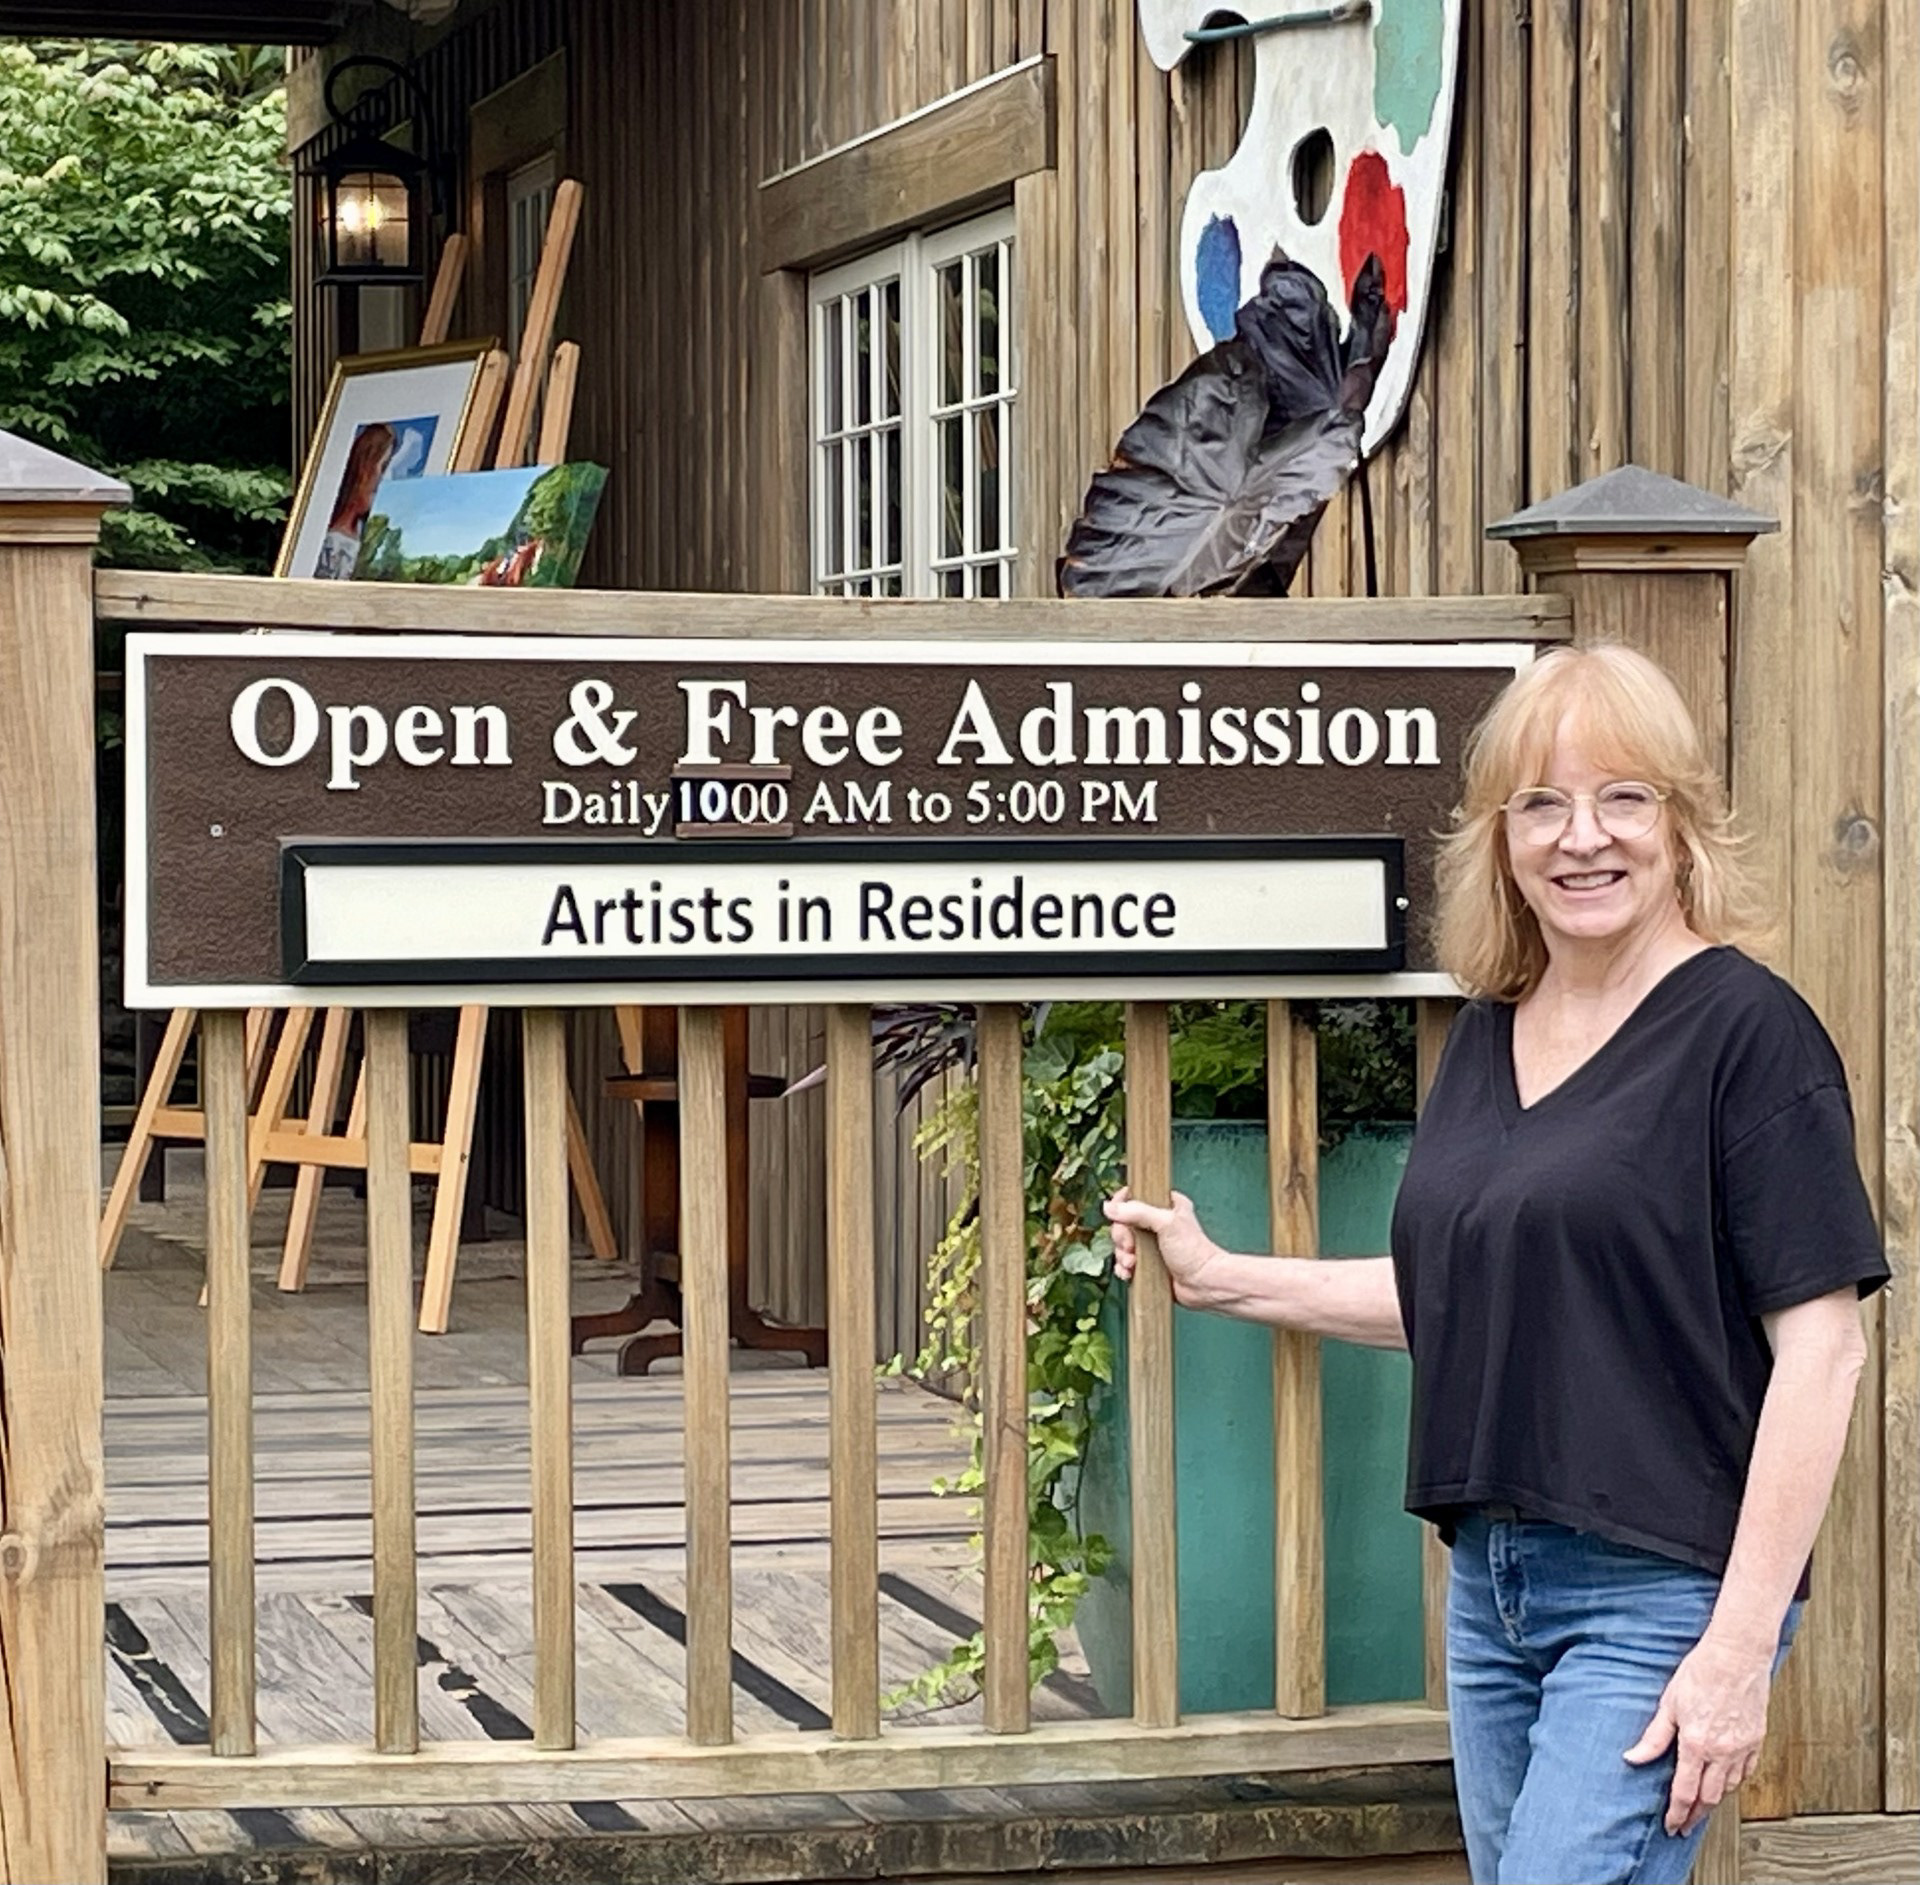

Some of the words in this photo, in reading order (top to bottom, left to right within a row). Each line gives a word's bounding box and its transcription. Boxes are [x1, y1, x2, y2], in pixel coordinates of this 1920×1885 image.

[230, 677, 513, 790] Open
[552, 679, 638, 766] &
[677, 680, 903, 766] Free
[936, 678, 1441, 766] Admission
[541, 780, 670, 836] Daily
[803, 780, 891, 824] AM
[907, 785, 952, 823] to
[966, 781, 1065, 823] 5:00
[1080, 780, 1158, 823] PM
[541, 880, 753, 945] Artists
[778, 880, 831, 941] in
[859, 876, 1177, 940] Residence
